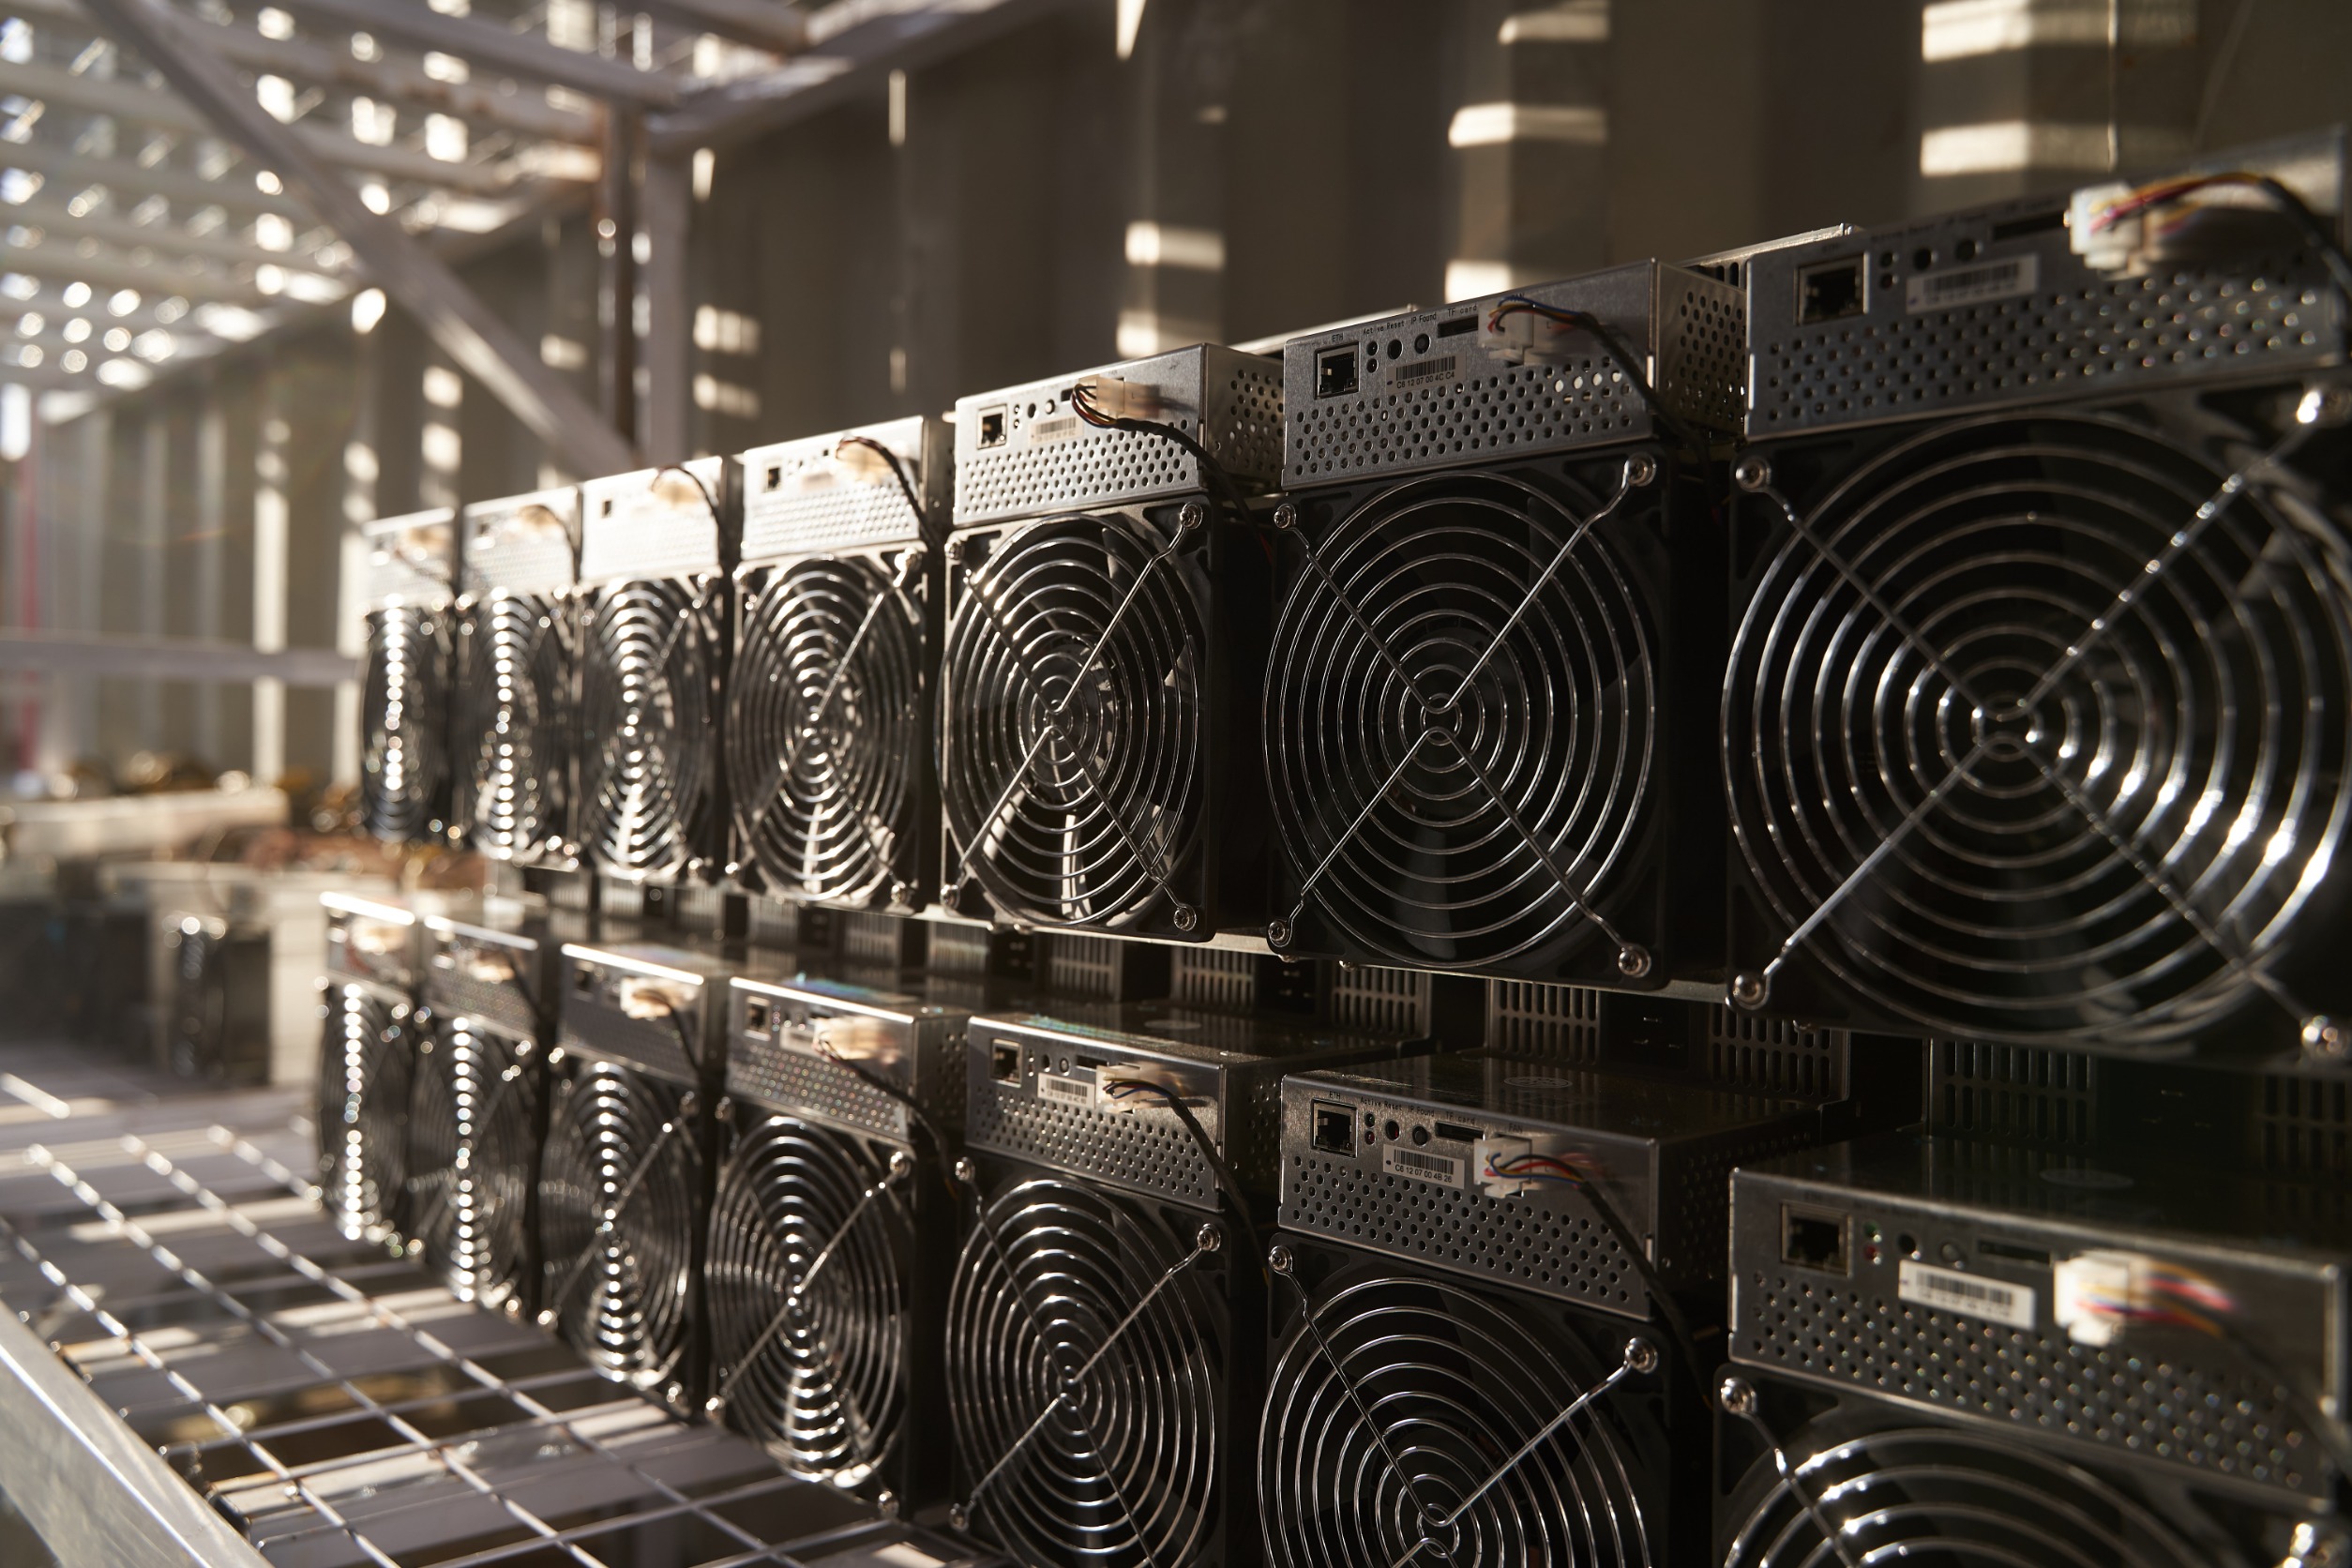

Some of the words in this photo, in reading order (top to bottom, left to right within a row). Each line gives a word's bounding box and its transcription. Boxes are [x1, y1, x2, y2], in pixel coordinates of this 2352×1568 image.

[1447, 308, 1455, 317] TF
[1459, 304, 1477, 314] card
[1410, 316, 1417, 325] IP
[1419, 311, 1437, 324] Found
[1363, 326, 1384, 335] Actve
[1386, 320, 1405, 330] Reset
[1332, 333, 1344, 342] ETH
[1396, 381, 1405, 389] C6
[1445, 371, 1455, 380] C4
[1329, 1091, 1341, 1099] ETH
[1360, 1096, 1381, 1108] Active
[1384, 1100, 1403, 1111] Reset
[1416, 1106, 1435, 1118] Found
[1457, 1116, 1475, 1125] card
[1508, 1123, 1523, 1133] FAN
[1395, 1164, 1404, 1172] C6
[1424, 1170, 1432, 1179] 00
